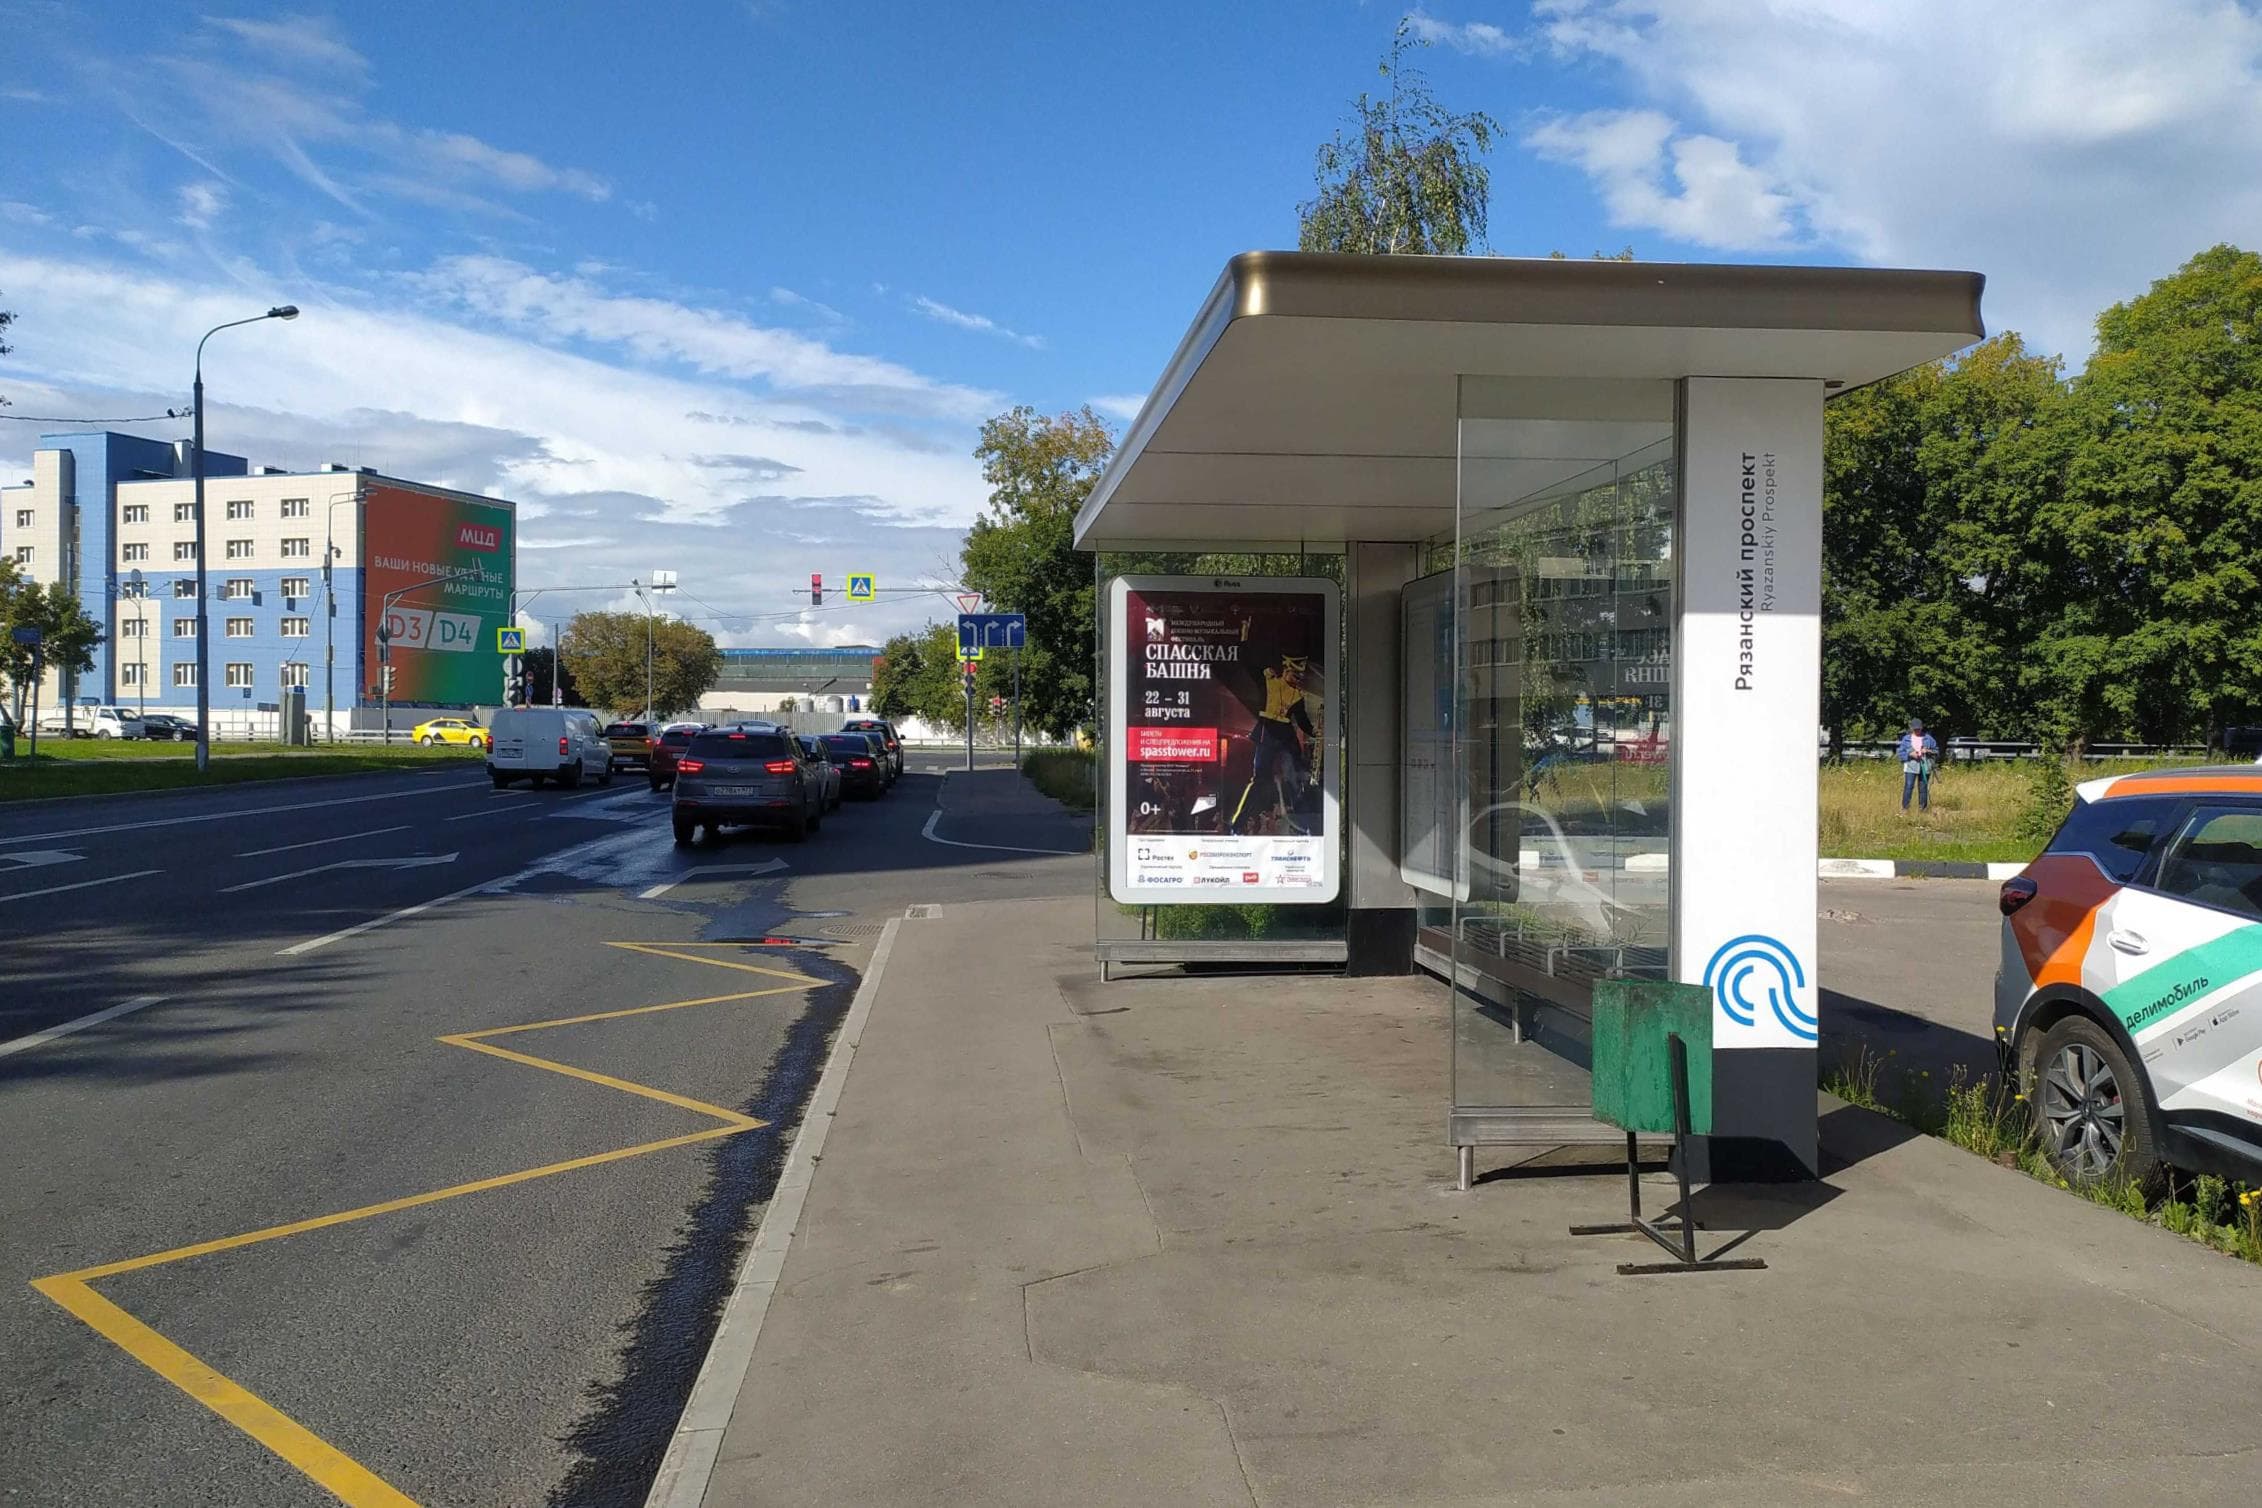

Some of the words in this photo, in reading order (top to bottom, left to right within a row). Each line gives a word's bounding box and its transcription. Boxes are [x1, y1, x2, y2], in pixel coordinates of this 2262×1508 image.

[1762, 452, 1777, 522] Prospekt
[1741, 452, 1758, 561] проспект
[460, 527, 496, 548] МЦД
[374, 555, 410, 572] ВАШИ
[413, 561, 451, 577] НОВЫЕ
[1761, 526, 1777, 612] Ryazanskiy
[444, 582, 504, 600] МАРШРУТЫ
[387, 614, 422, 641] D3
[440, 619, 472, 645] D4
[1735, 568, 1754, 691] Рязанский
[1145, 643, 1240, 661] СПАССКАЯ
[1145, 662, 1212, 679] БАШНЯ
[1145, 691, 1160, 705] 22
[1177, 691, 1190, 705] 31
[1144, 707, 1191, 720] августа
[1140, 746, 1211, 759] spasstower.ru
[1140, 802, 1161, 815] 0+
[2126, 976, 2209, 1032] делимобиль
